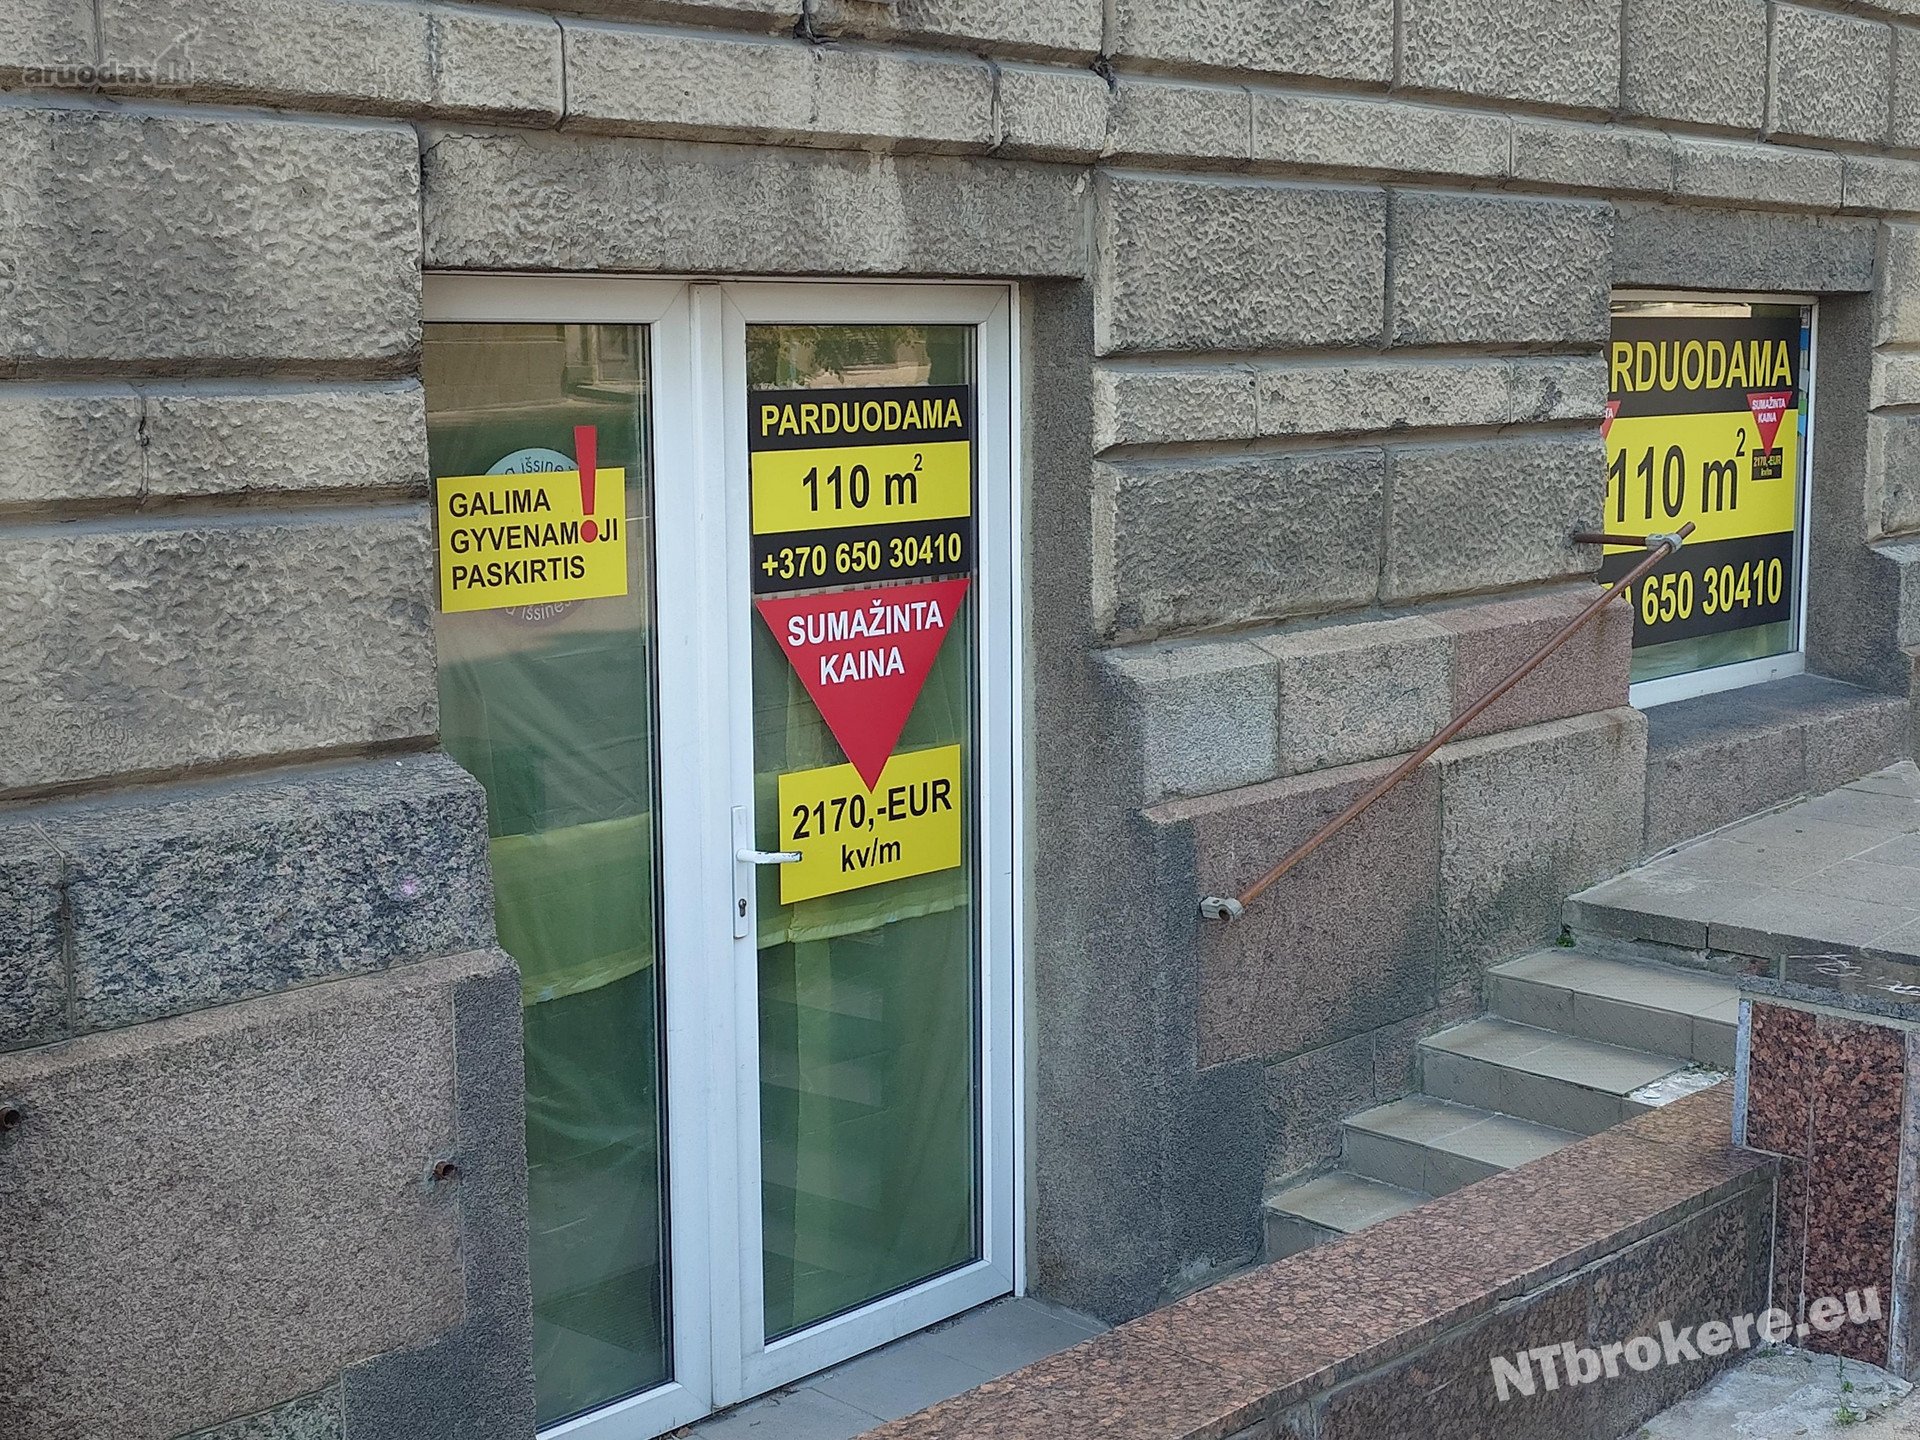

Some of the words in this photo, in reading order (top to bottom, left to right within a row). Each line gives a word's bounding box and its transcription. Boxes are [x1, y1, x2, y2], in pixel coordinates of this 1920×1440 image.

[1608, 340, 1793, 393] RDUODAMA
[761, 398, 963, 437] PARDUODAMA
[449, 488, 551, 518] GALIMA
[803, 464, 870, 512] 110
[1609, 445, 1686, 523] 110
[452, 555, 586, 591] PASKIRTIS
[762, 544, 827, 580] +370
[835, 540, 881, 573] 650
[889, 532, 962, 568] 30410
[1641, 571, 1694, 626] 650
[1702, 557, 1783, 616] 30410
[787, 599, 944, 647] SUMAŽINTA
[820, 646, 905, 685] KAINA
[792, 777, 953, 840] 2170,-EUR
[840, 837, 901, 873] kv/m
